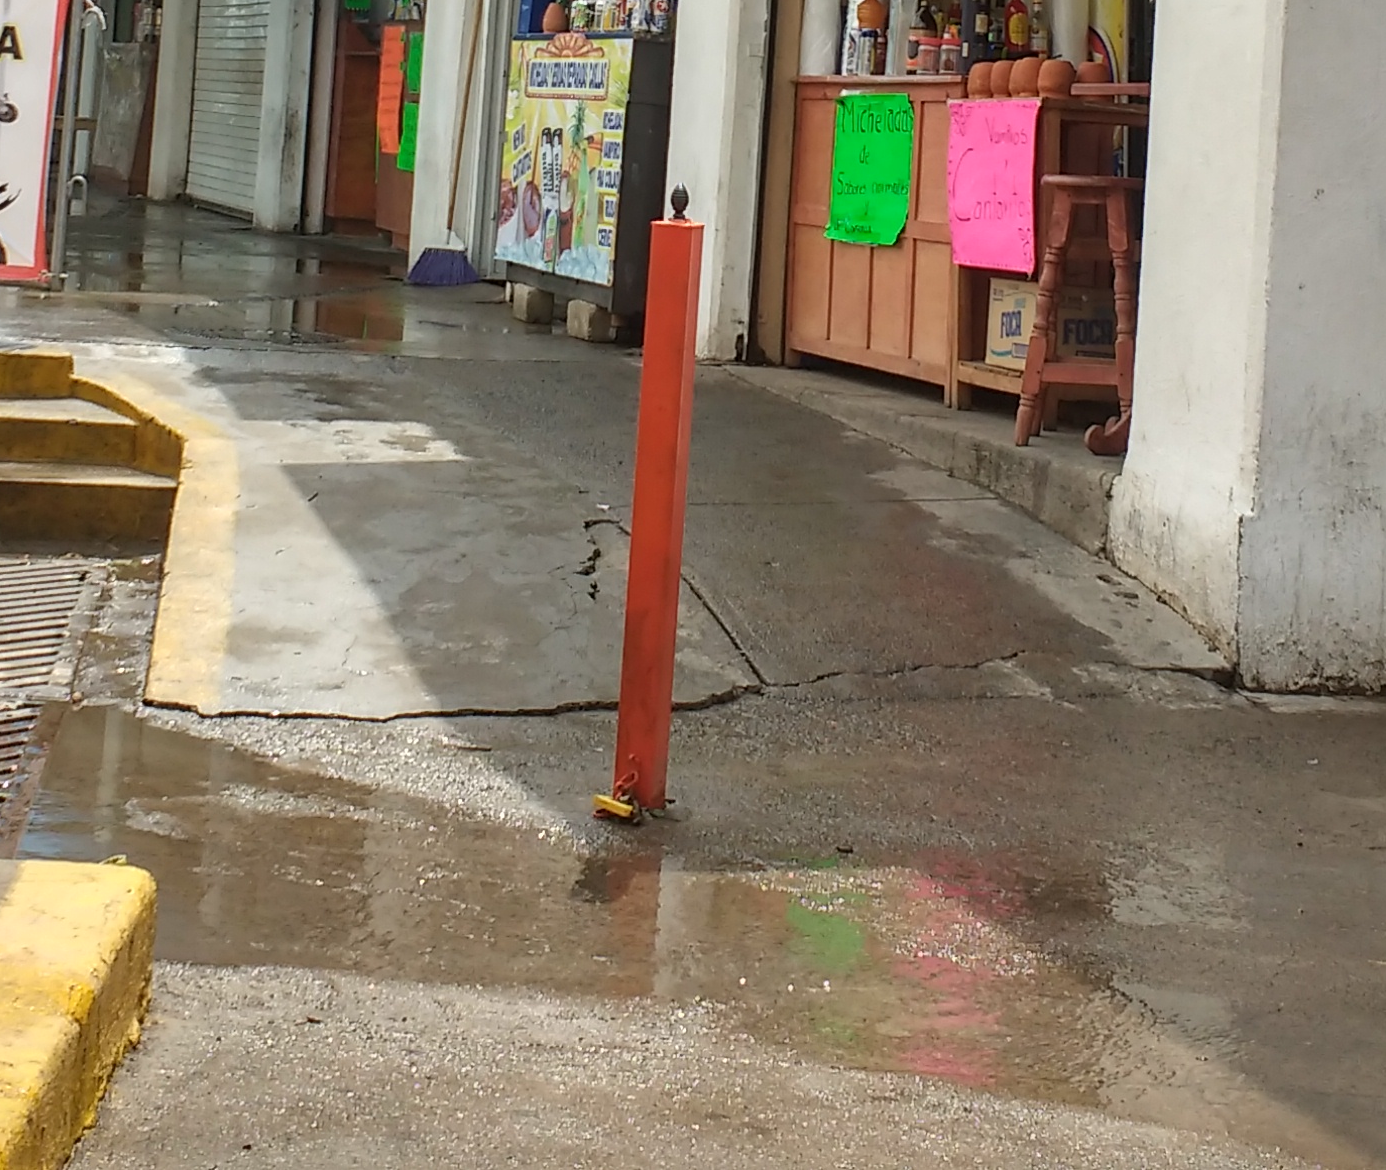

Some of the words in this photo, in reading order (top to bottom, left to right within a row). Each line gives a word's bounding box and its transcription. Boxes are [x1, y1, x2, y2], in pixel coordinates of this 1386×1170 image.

[840, 100, 914, 134] Micheladas
[859, 145, 870, 166] de
[1000, 309, 1022, 338] FOCA
[1063, 318, 1113, 346] FOCA
